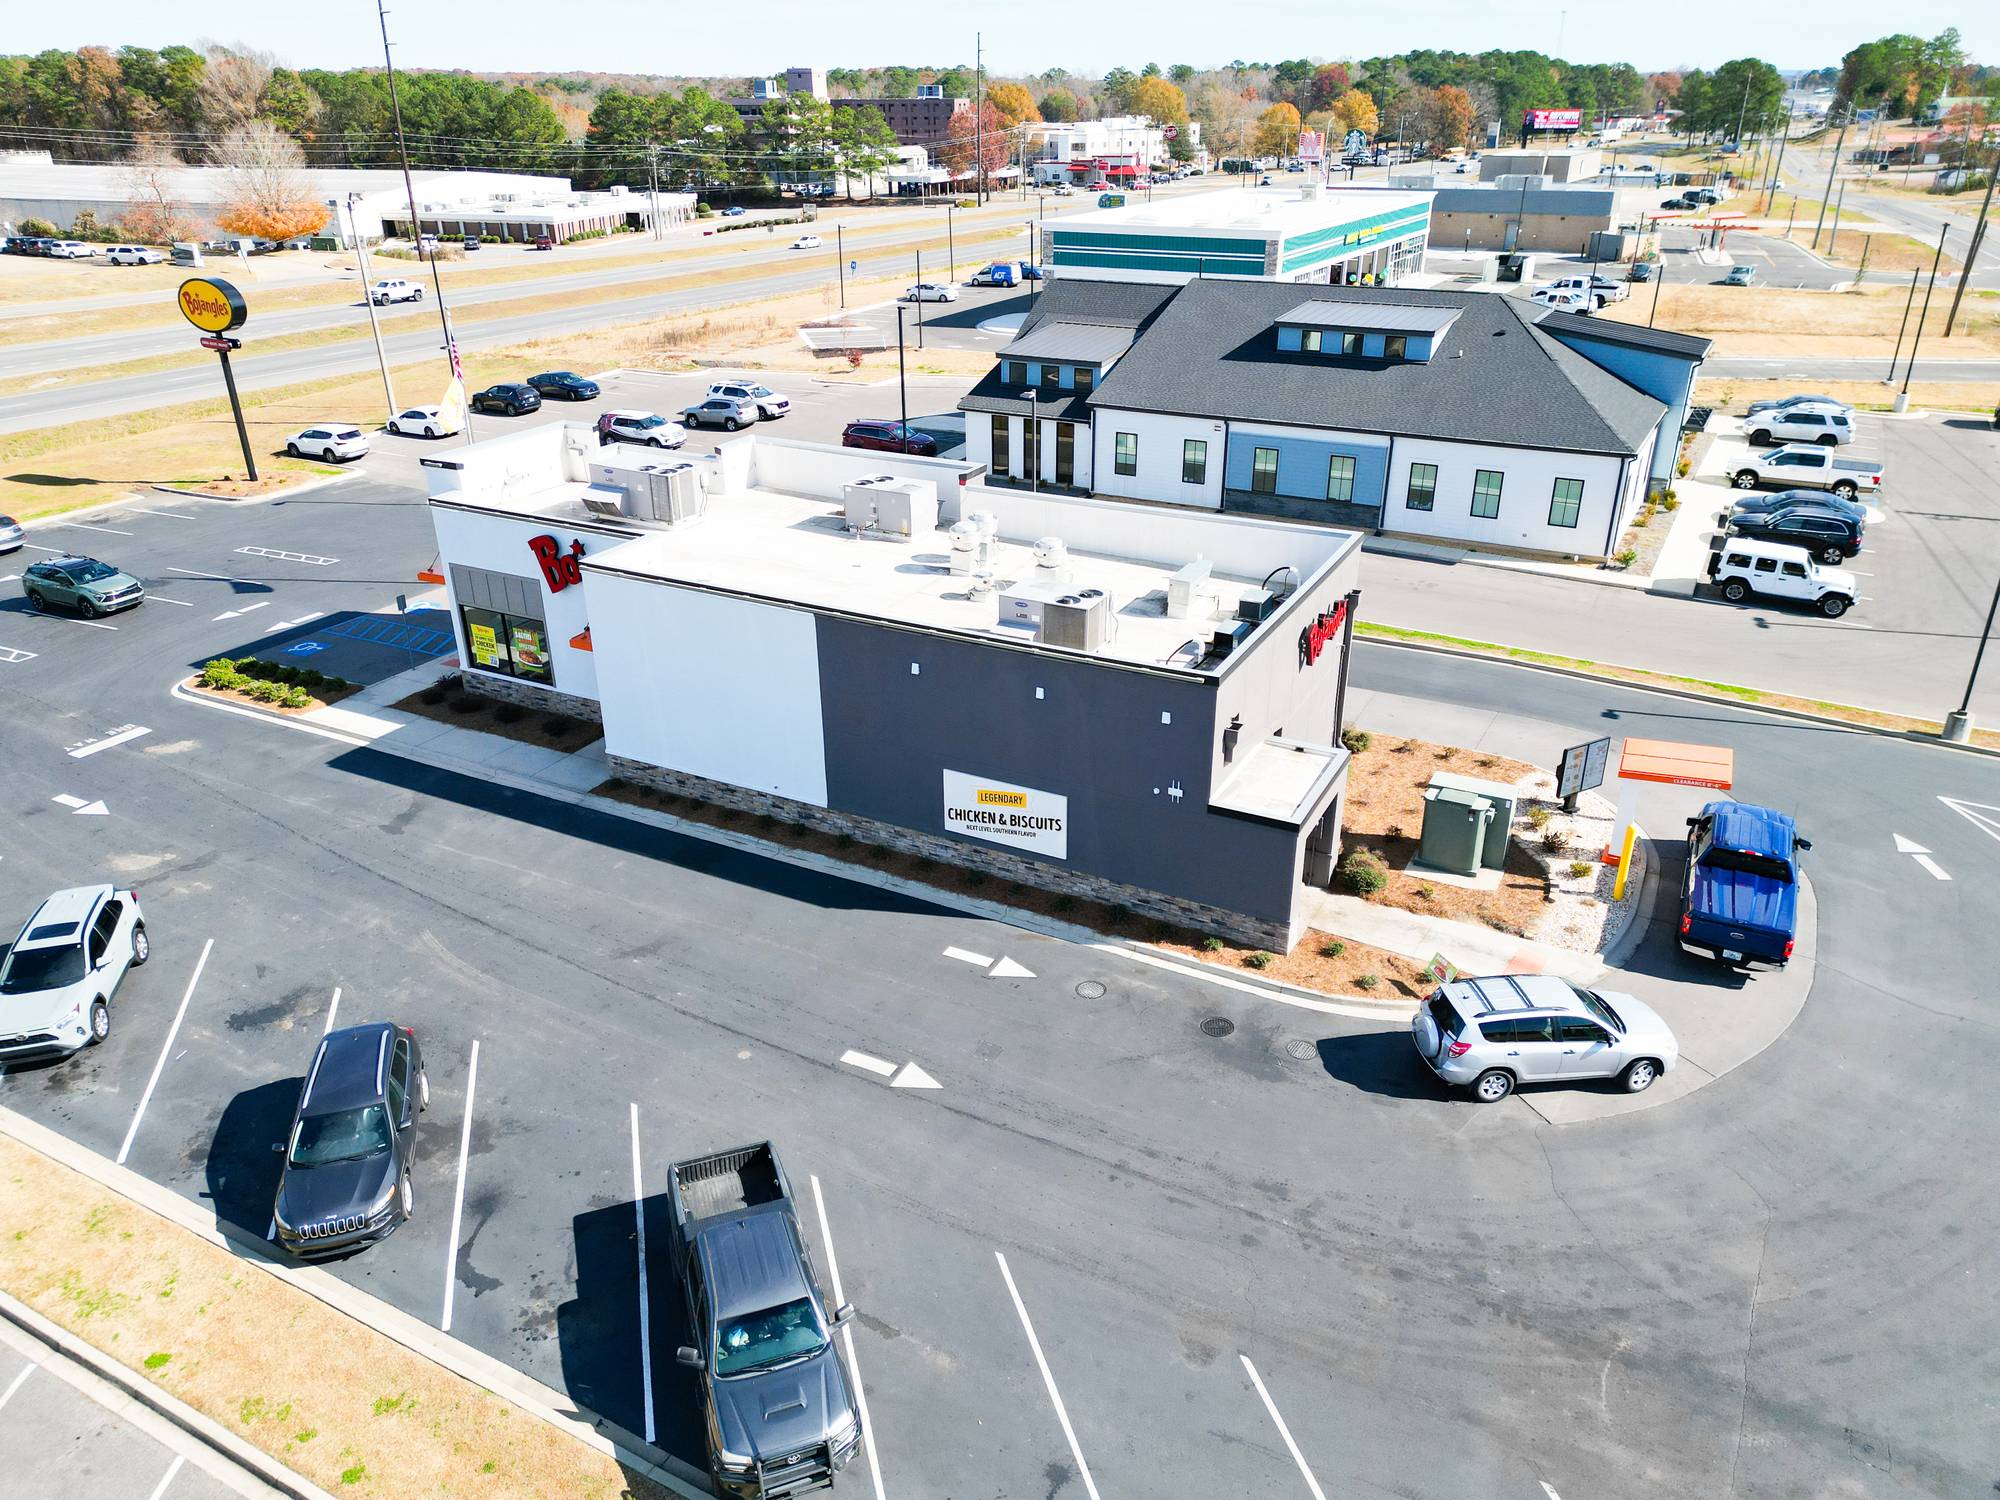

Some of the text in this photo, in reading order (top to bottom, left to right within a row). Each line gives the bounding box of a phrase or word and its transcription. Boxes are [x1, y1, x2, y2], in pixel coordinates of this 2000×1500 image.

[994, 271, 1007, 279] ADT
[182, 291, 228, 318] Bojangles
[528, 535, 586, 593] Bo
[1673, 778, 1706, 787] CLEARANCE
[980, 793, 1023, 805] LEGENDARY
[947, 807, 1062, 831] CHICKEN & BISCUITS
[992, 827, 1018, 835] SOUTHERN
